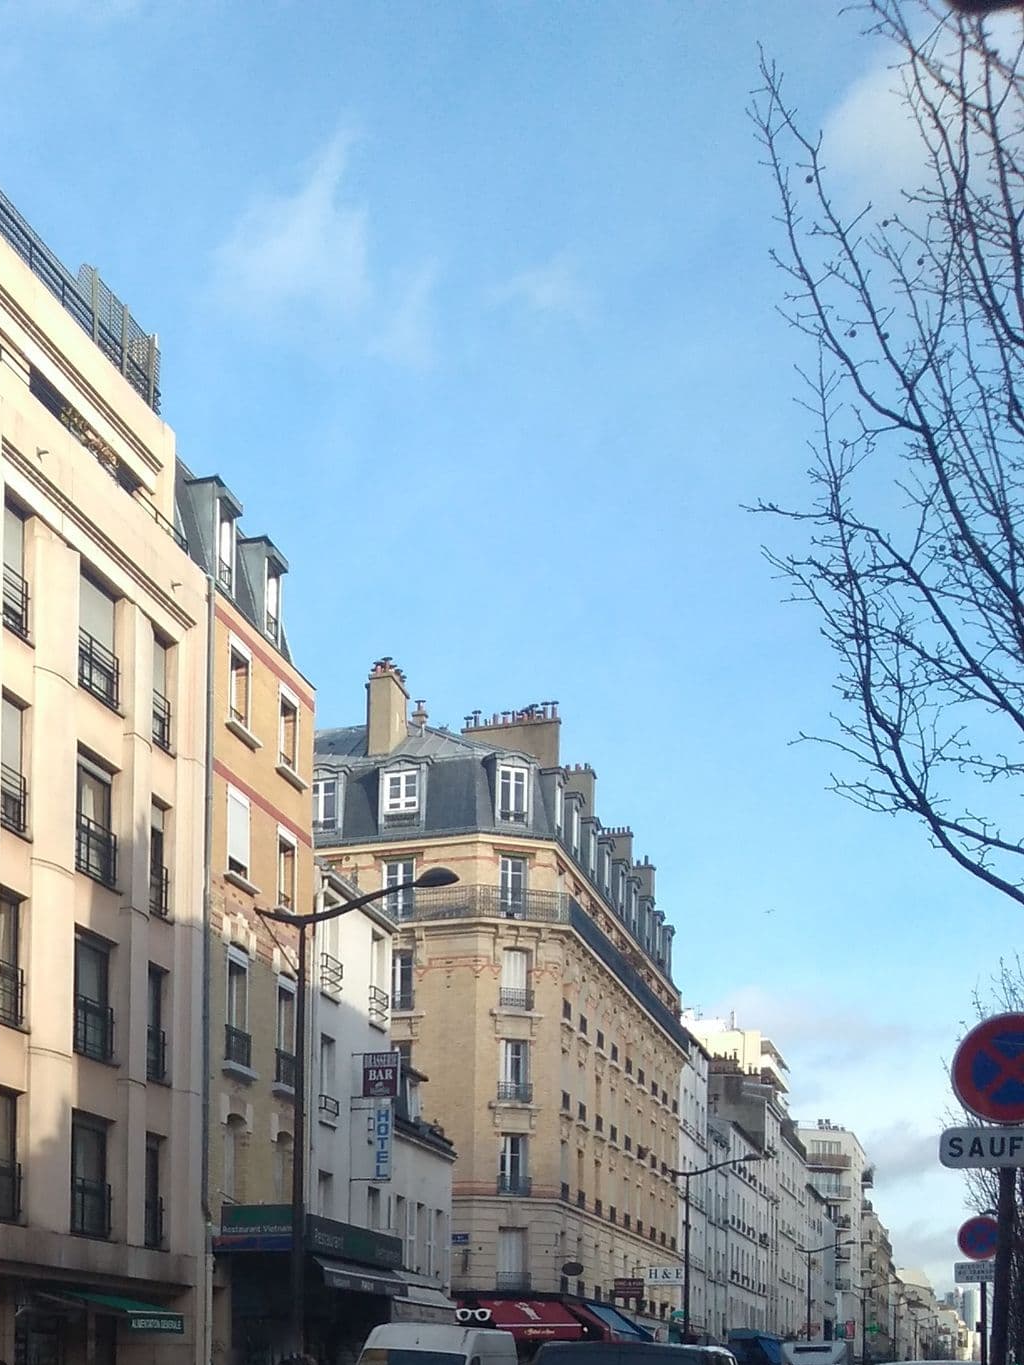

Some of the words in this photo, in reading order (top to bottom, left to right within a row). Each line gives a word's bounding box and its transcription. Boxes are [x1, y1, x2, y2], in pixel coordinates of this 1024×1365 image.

[368, 1068, 393, 1081] BAR
[376, 1109, 390, 1177] HOTEL
[948, 1136, 1024, 1158] SAUF
[648, 1268, 658, 1279] H
[662, 1268, 672, 1279] &
